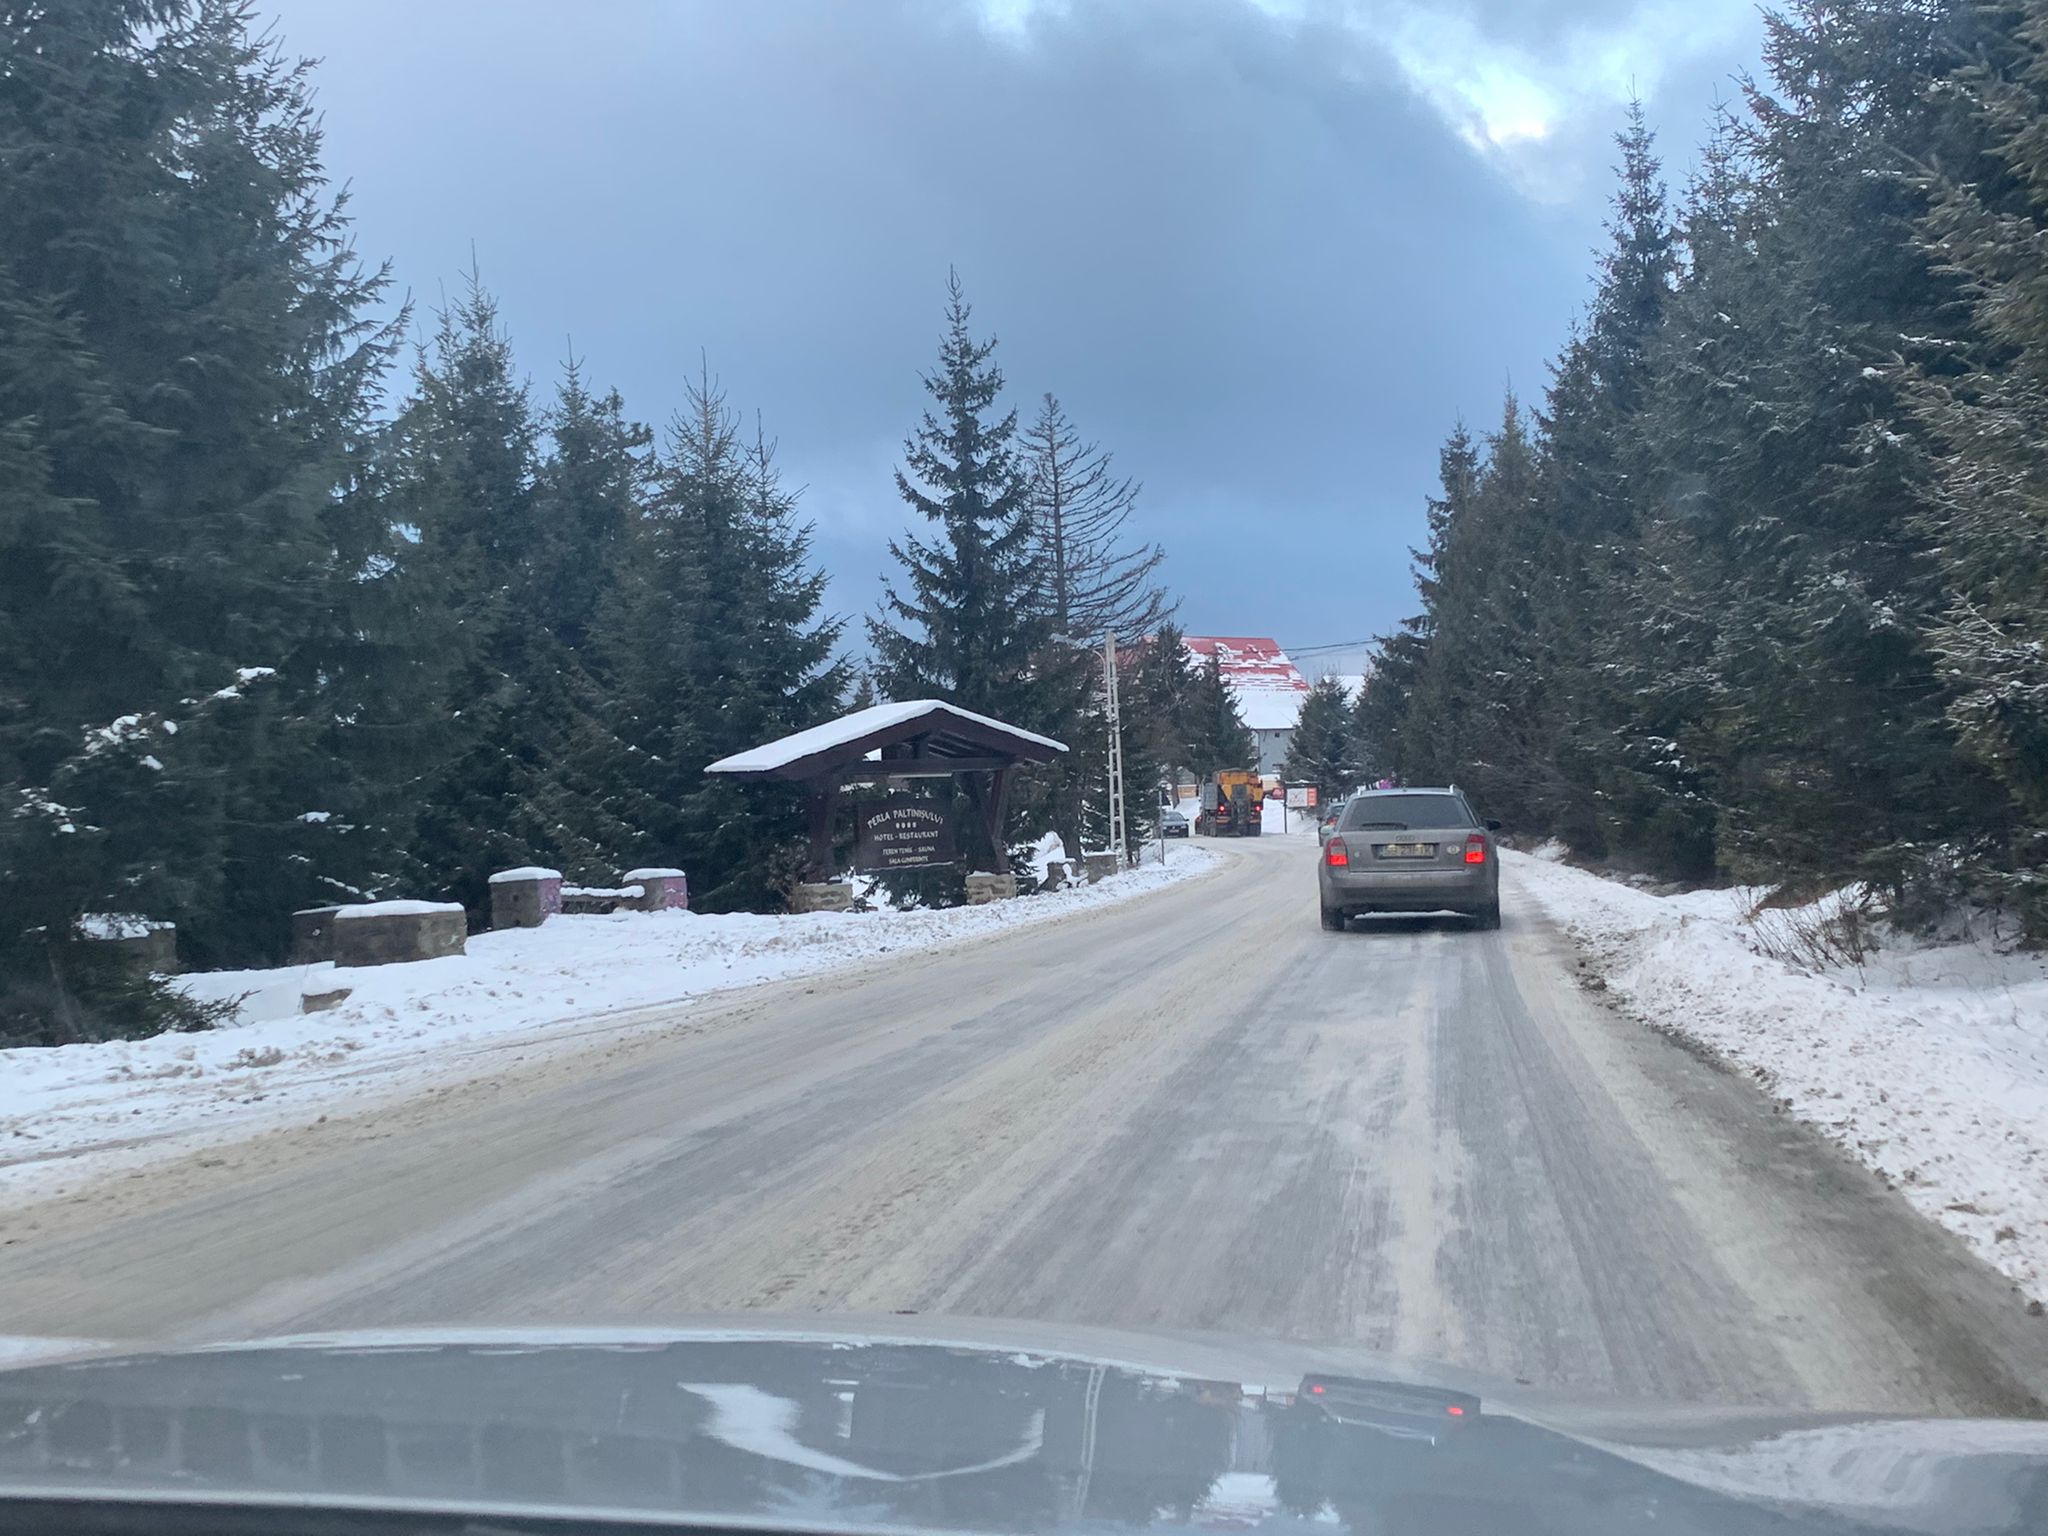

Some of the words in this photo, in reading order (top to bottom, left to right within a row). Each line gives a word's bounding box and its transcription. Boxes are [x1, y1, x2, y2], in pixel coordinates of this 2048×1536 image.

[867, 812, 891, 829] PERLA
[874, 833, 894, 841] HOTEL
[899, 831, 938, 840] RESTAURANT
